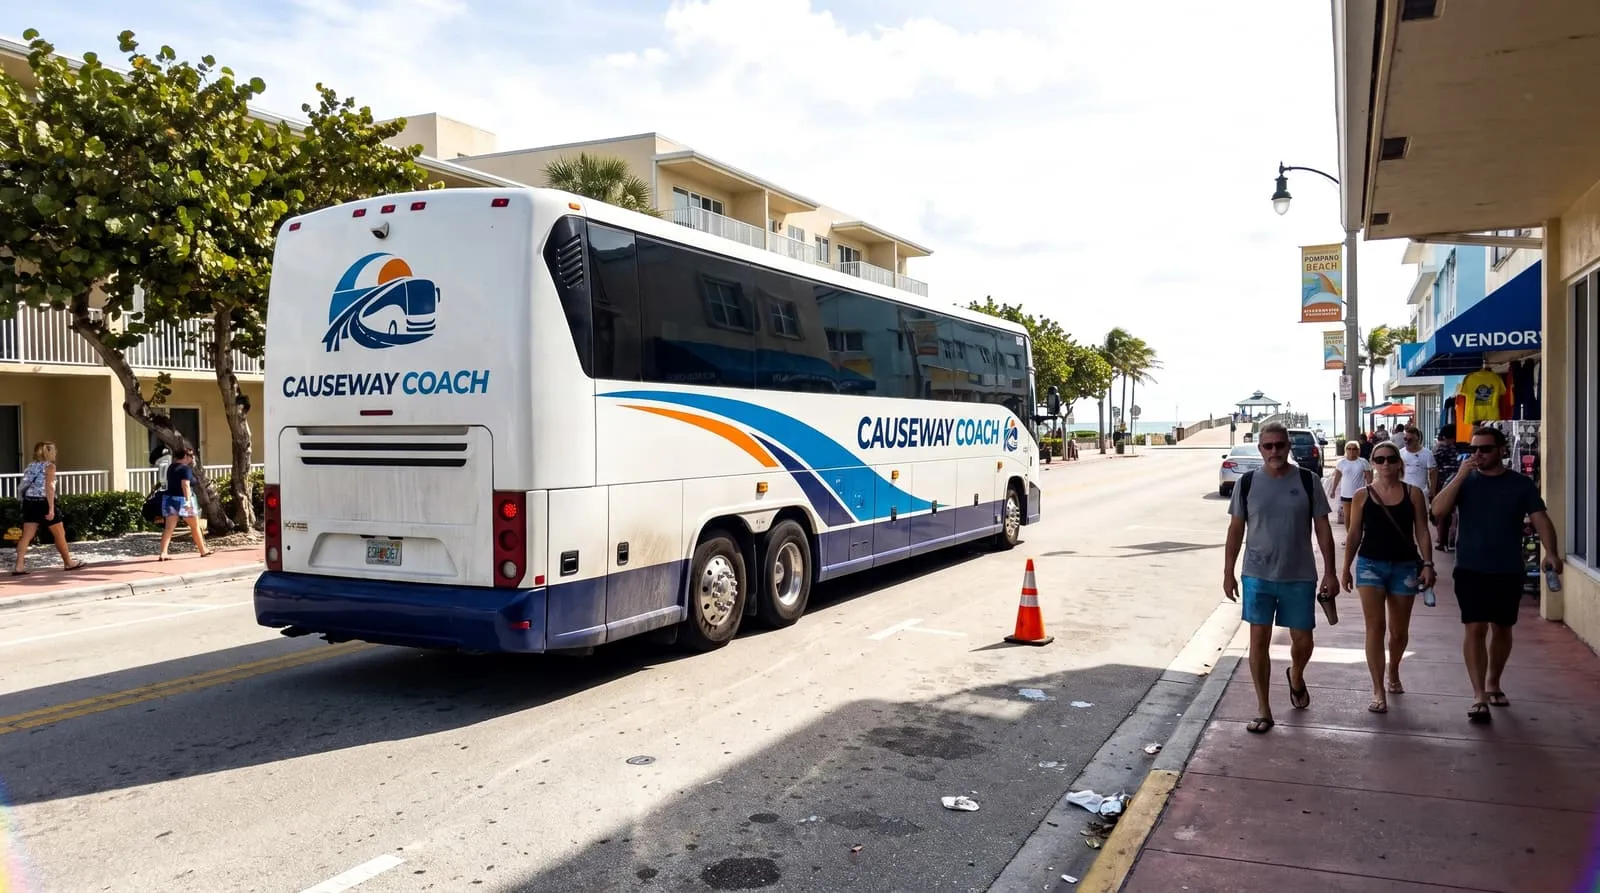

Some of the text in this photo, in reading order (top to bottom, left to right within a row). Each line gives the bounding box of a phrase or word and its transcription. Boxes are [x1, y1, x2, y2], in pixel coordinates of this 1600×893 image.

[1304, 254, 1339, 262] POMPANO
[1306, 262, 1337, 271] BEACH
[1451, 330, 1542, 348] VENDOR
[283, 370, 490, 397] CAUSEWAY COACH
[857, 416, 999, 449] CAUSEWAY COACH
